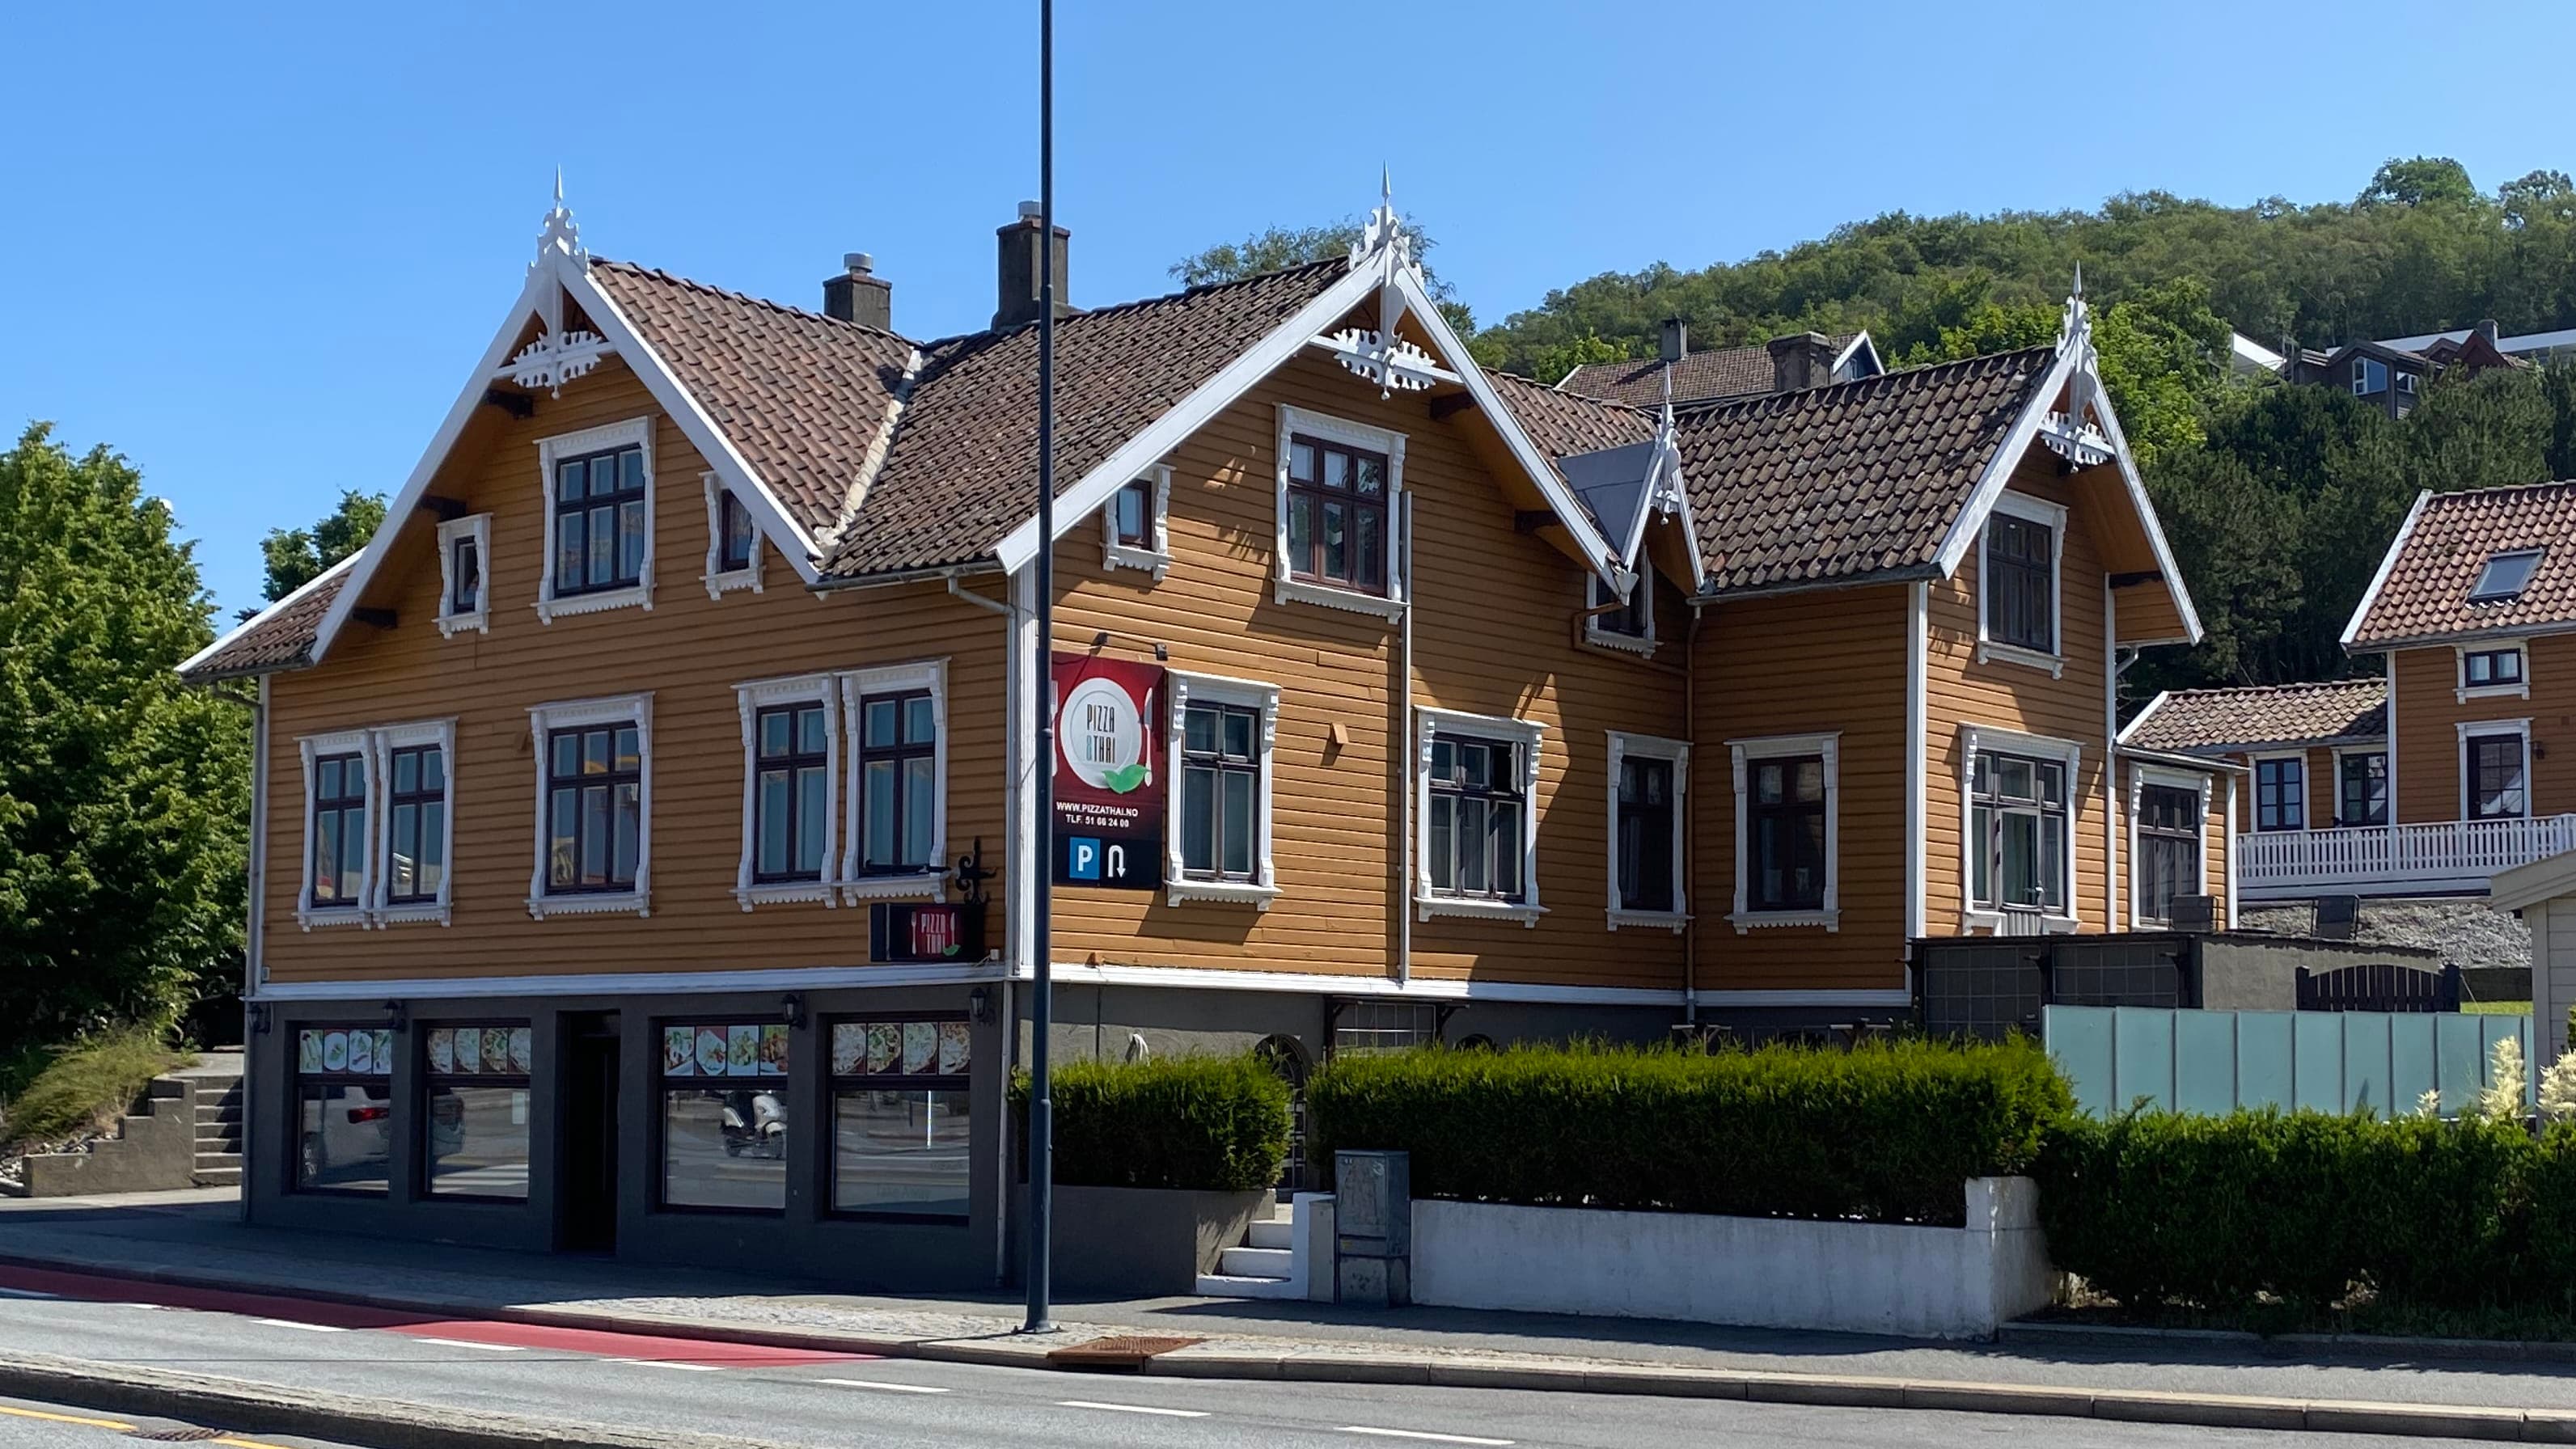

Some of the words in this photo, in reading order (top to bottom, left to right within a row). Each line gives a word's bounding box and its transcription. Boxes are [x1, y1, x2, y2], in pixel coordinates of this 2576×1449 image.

[1086, 703, 1115, 733] PIZZA
[1055, 801, 1139, 817] WWW.PIZZATHAI.NO
[1065, 813, 1082, 824] TLF.
[1085, 815, 1094, 825] 51
[1108, 817, 1118, 827] 24
[1077, 844, 1093, 872] P
[920, 913, 946, 933] PIZZA
